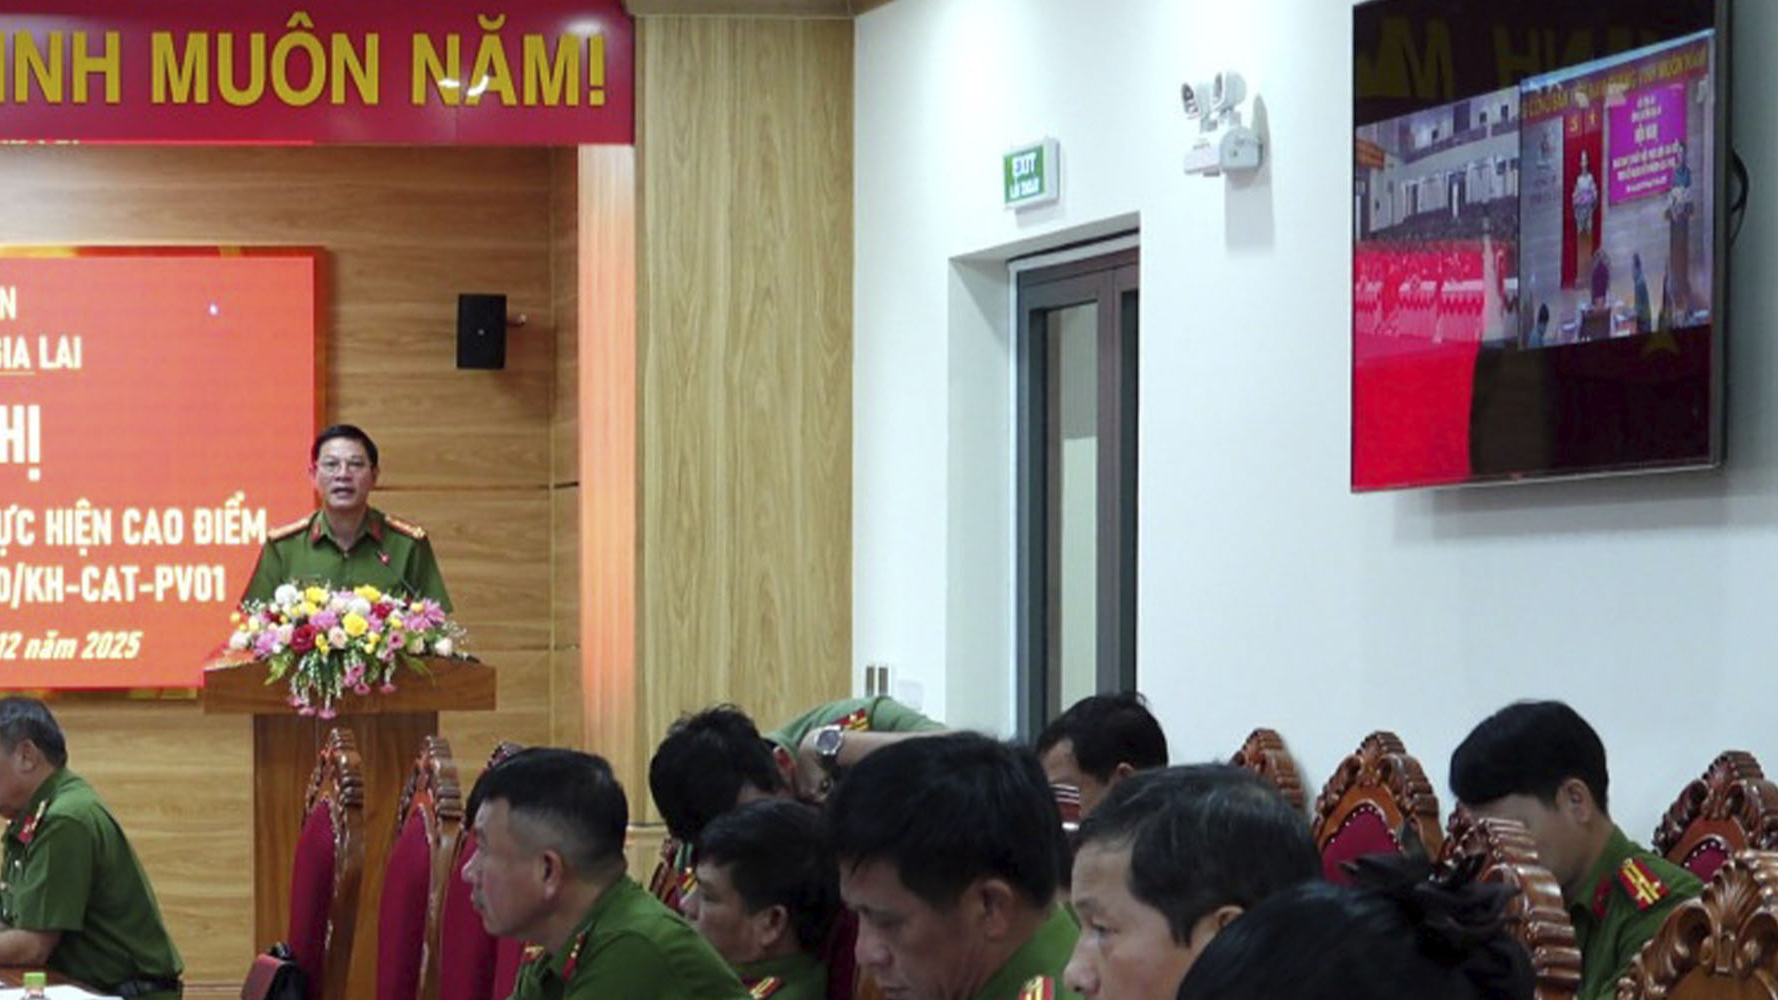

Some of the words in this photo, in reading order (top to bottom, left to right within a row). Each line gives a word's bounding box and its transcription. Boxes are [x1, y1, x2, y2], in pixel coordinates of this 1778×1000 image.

[152, 12, 379, 106] MUÔN
[412, 14, 606, 107] NĂM!
[40, 336, 81, 369] LAI
[45, 497, 112, 556] HIỆN
[122, 509, 183, 546] CAO
[193, 491, 267, 546] ĐIỂM
[25, 631, 78, 660] năm
[82, 631, 142, 659] 2025
